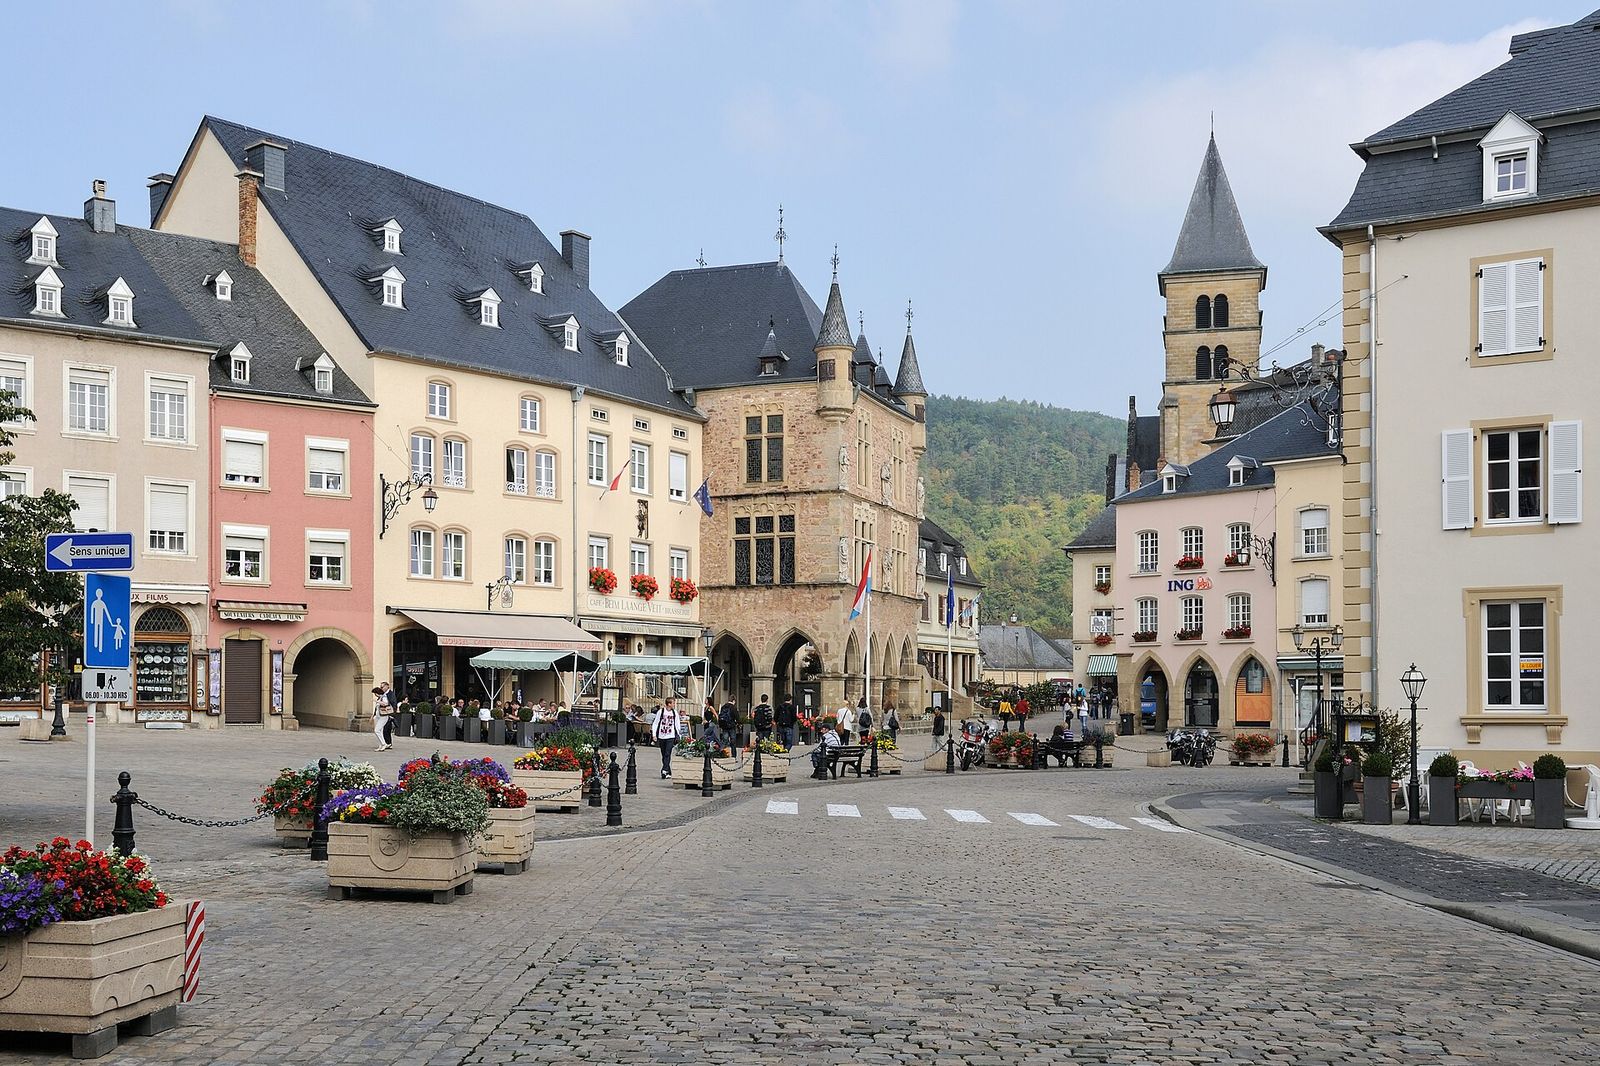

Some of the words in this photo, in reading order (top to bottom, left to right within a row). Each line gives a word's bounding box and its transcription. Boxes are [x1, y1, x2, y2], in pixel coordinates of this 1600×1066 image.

[69, 547, 92, 556] Sens
[95, 546, 126, 557] unique
[1167, 579, 1194, 592] ING
[117, 691, 128, 699] HRS
